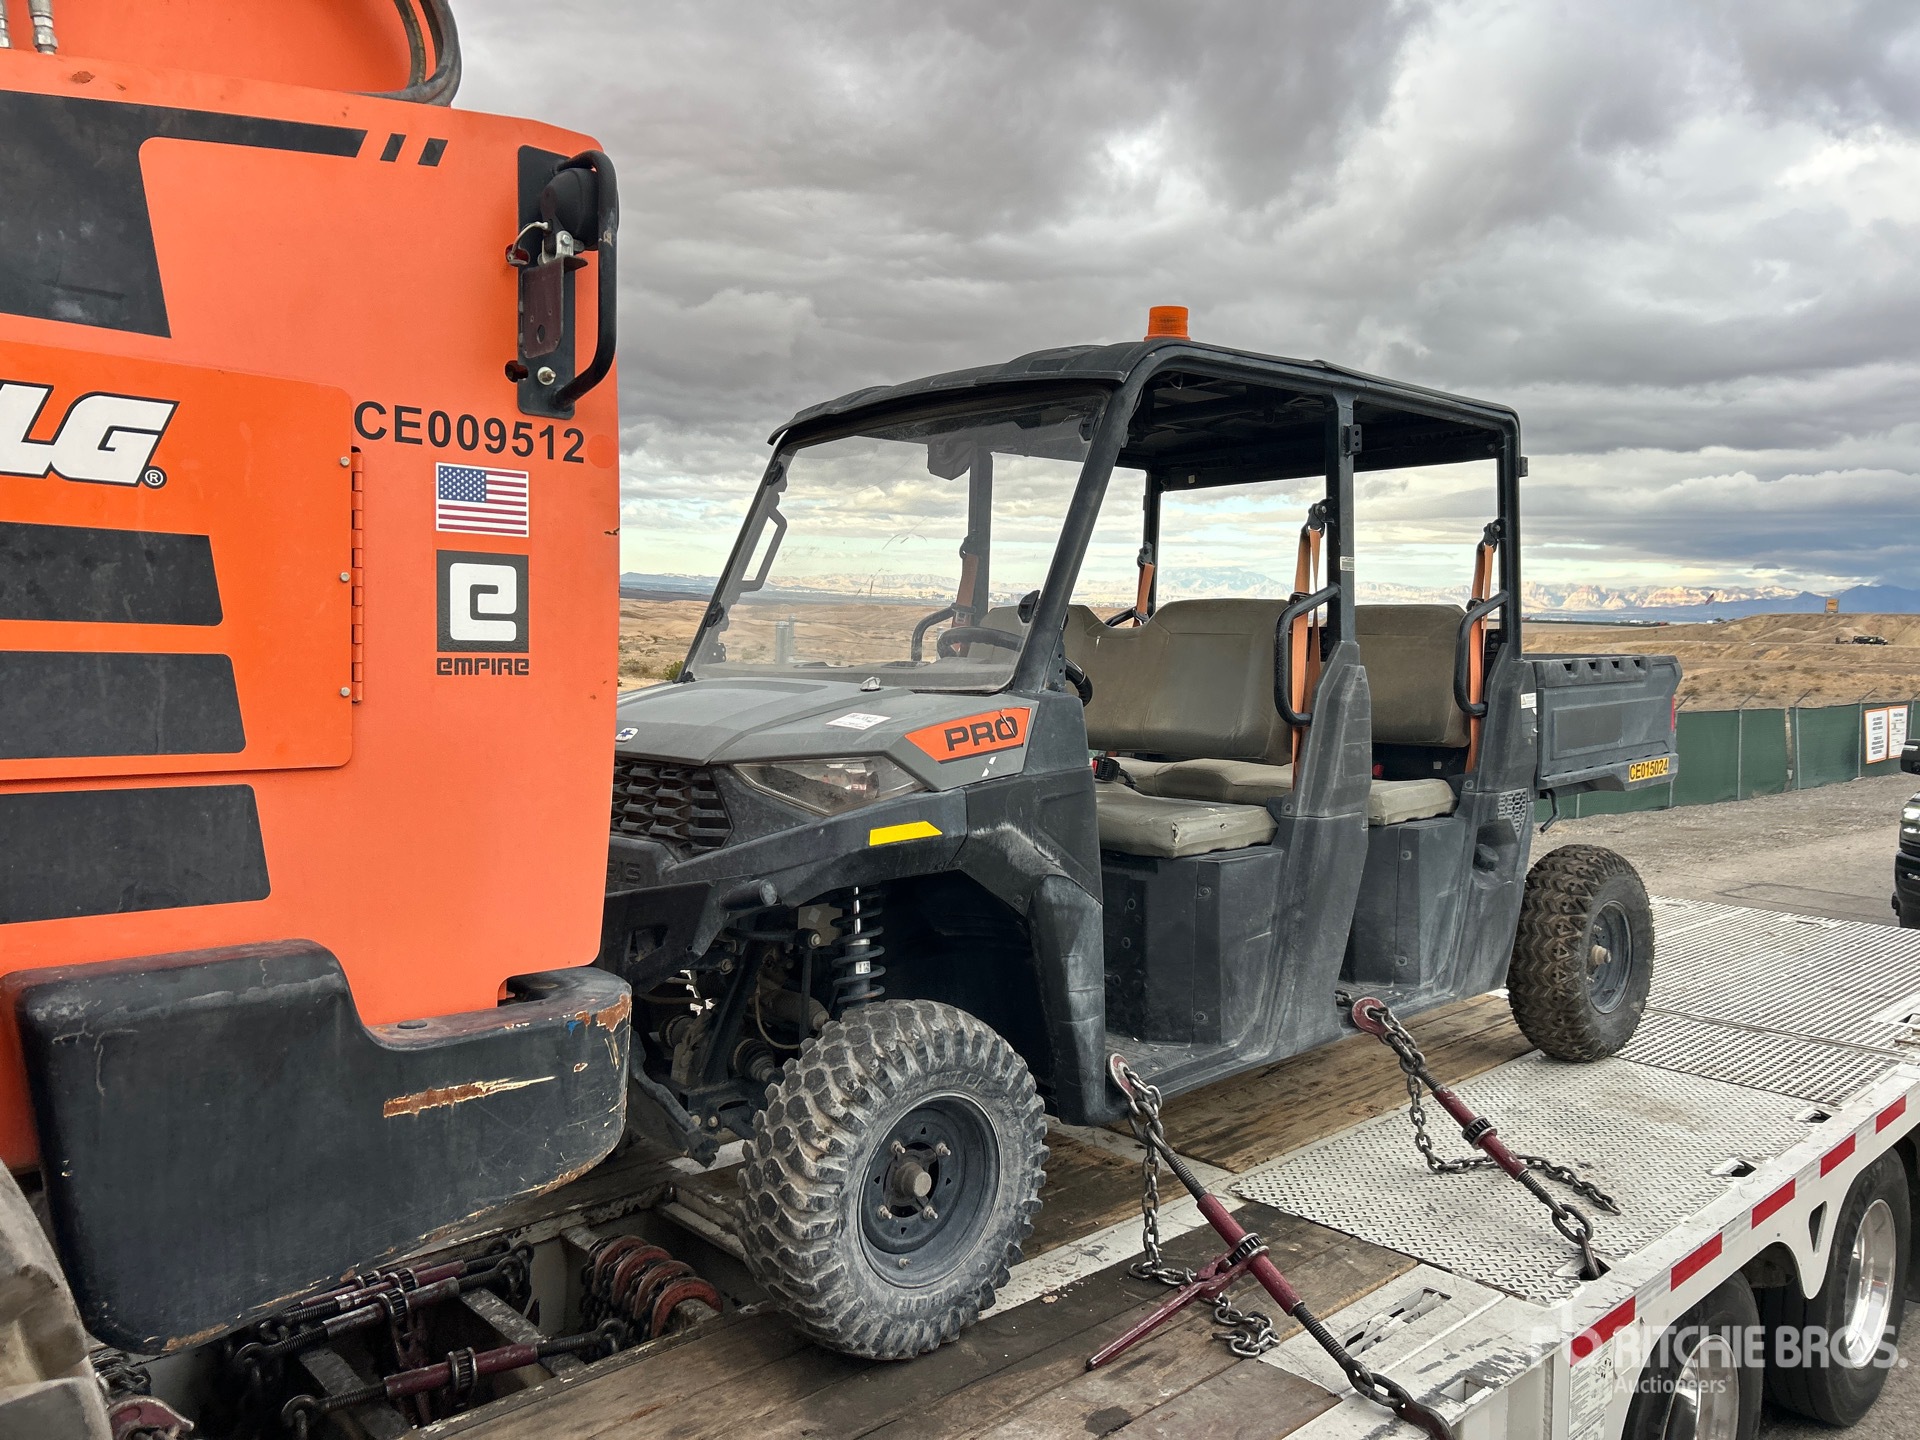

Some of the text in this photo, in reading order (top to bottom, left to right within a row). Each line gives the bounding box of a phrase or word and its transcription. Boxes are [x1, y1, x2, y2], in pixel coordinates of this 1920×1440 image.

[354, 401, 585, 464] CE009512
[436, 657, 530, 675] EMPIRE
[944, 716, 1019, 752] PRO
[1629, 758, 1669, 780] CE015024
